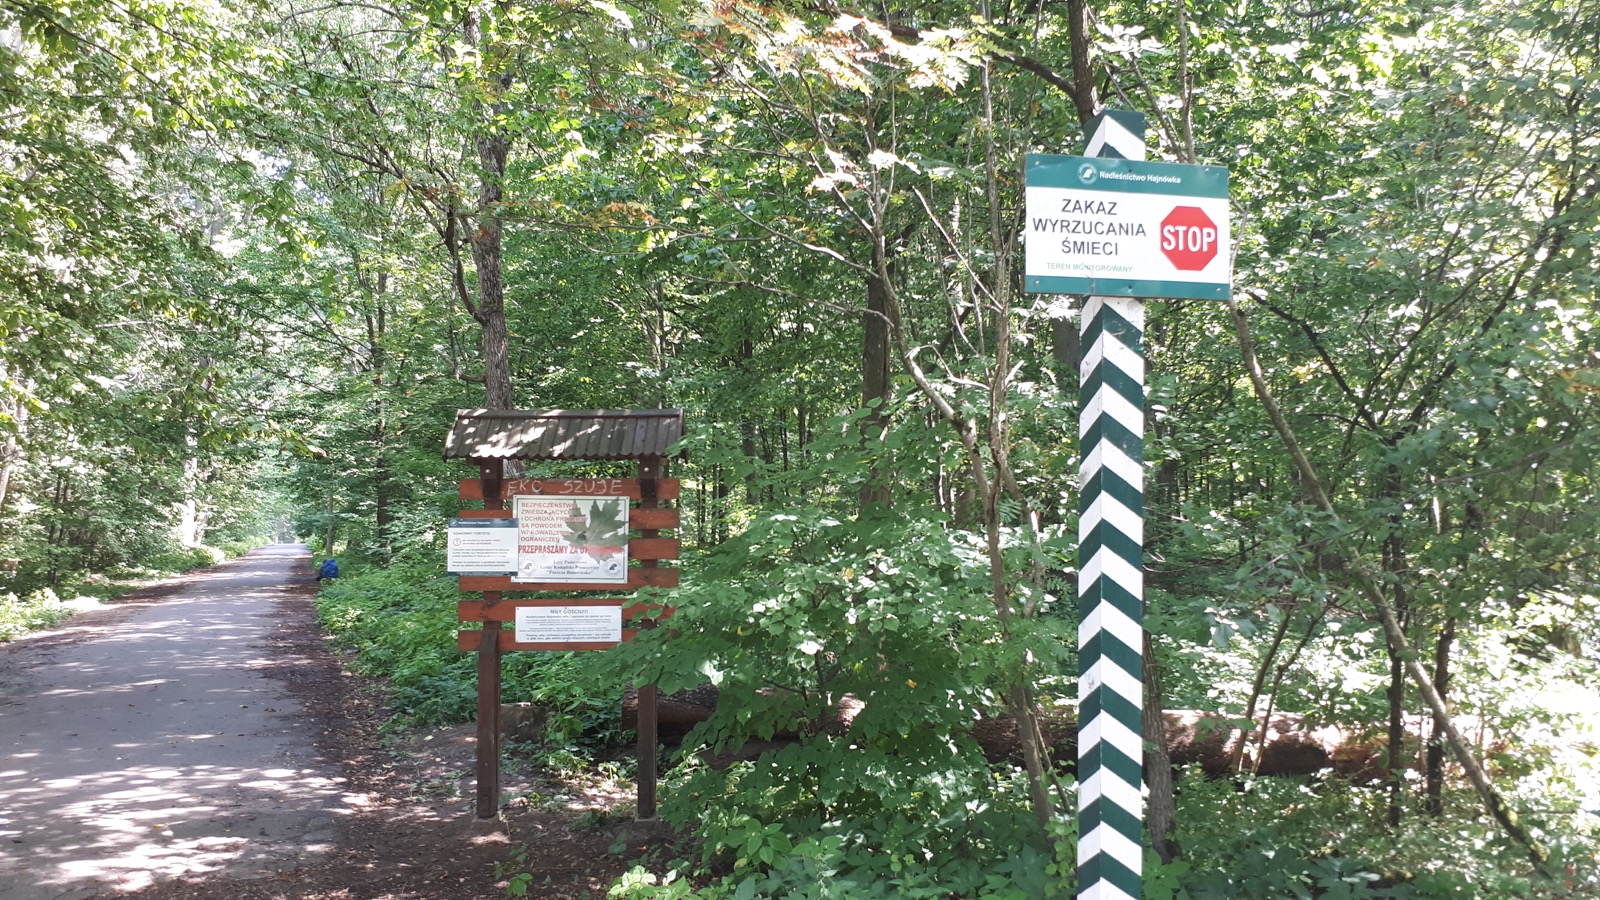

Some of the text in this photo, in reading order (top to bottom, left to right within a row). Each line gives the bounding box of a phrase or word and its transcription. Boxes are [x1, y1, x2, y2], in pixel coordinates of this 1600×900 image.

[1099, 170, 1146, 182] Nadleśnictwo
[1147, 173, 1182, 185] Hajnówka
[1061, 198, 1118, 216] ZAKAZ
[1032, 217, 1147, 238] WYRZUCANIA
[1061, 236, 1119, 256] ŚMIECI
[1162, 224, 1216, 253] STOP
[1046, 262, 1133, 273] TEREN MONITOROWANY
[559, 479, 623, 495] SZUJE
[519, 545, 569, 554] PRZEPRASZAMY
